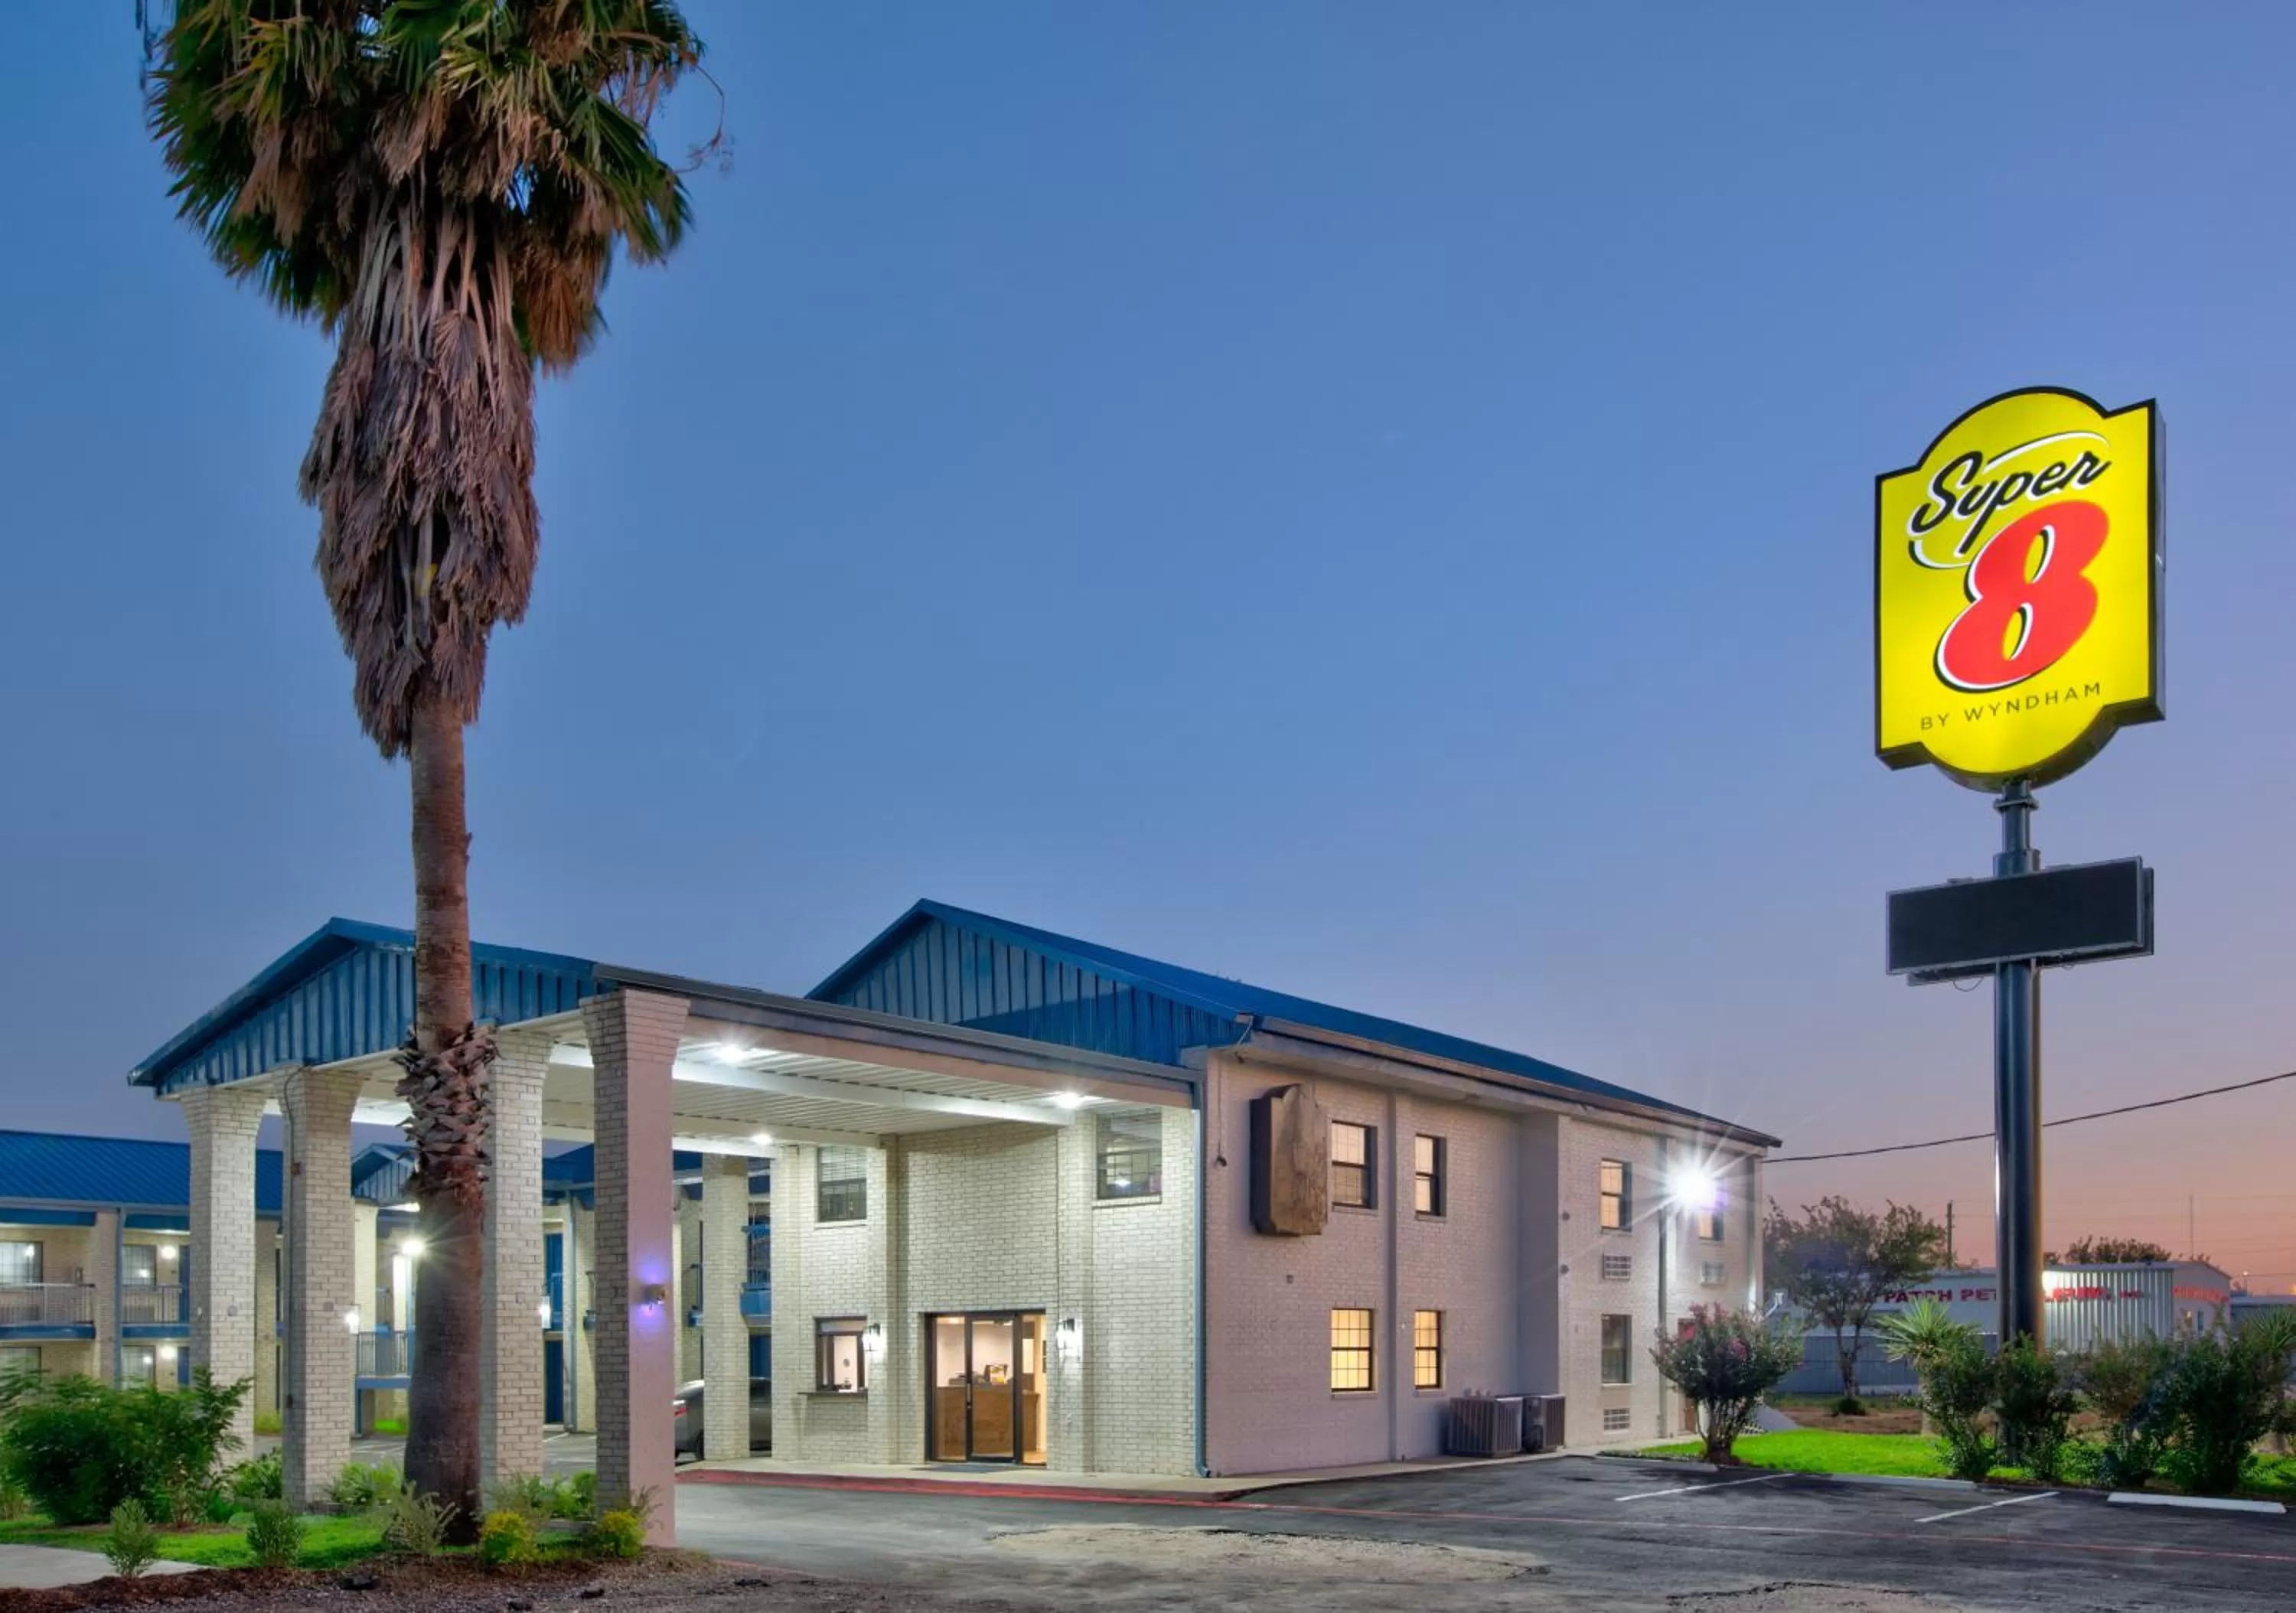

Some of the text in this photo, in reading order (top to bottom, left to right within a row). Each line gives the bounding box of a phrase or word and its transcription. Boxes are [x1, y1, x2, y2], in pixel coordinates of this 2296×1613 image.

[1907, 451, 2112, 558] Super
[1932, 499, 2110, 694] 8
[1920, 682, 2101, 730] BY WYNDHAM
